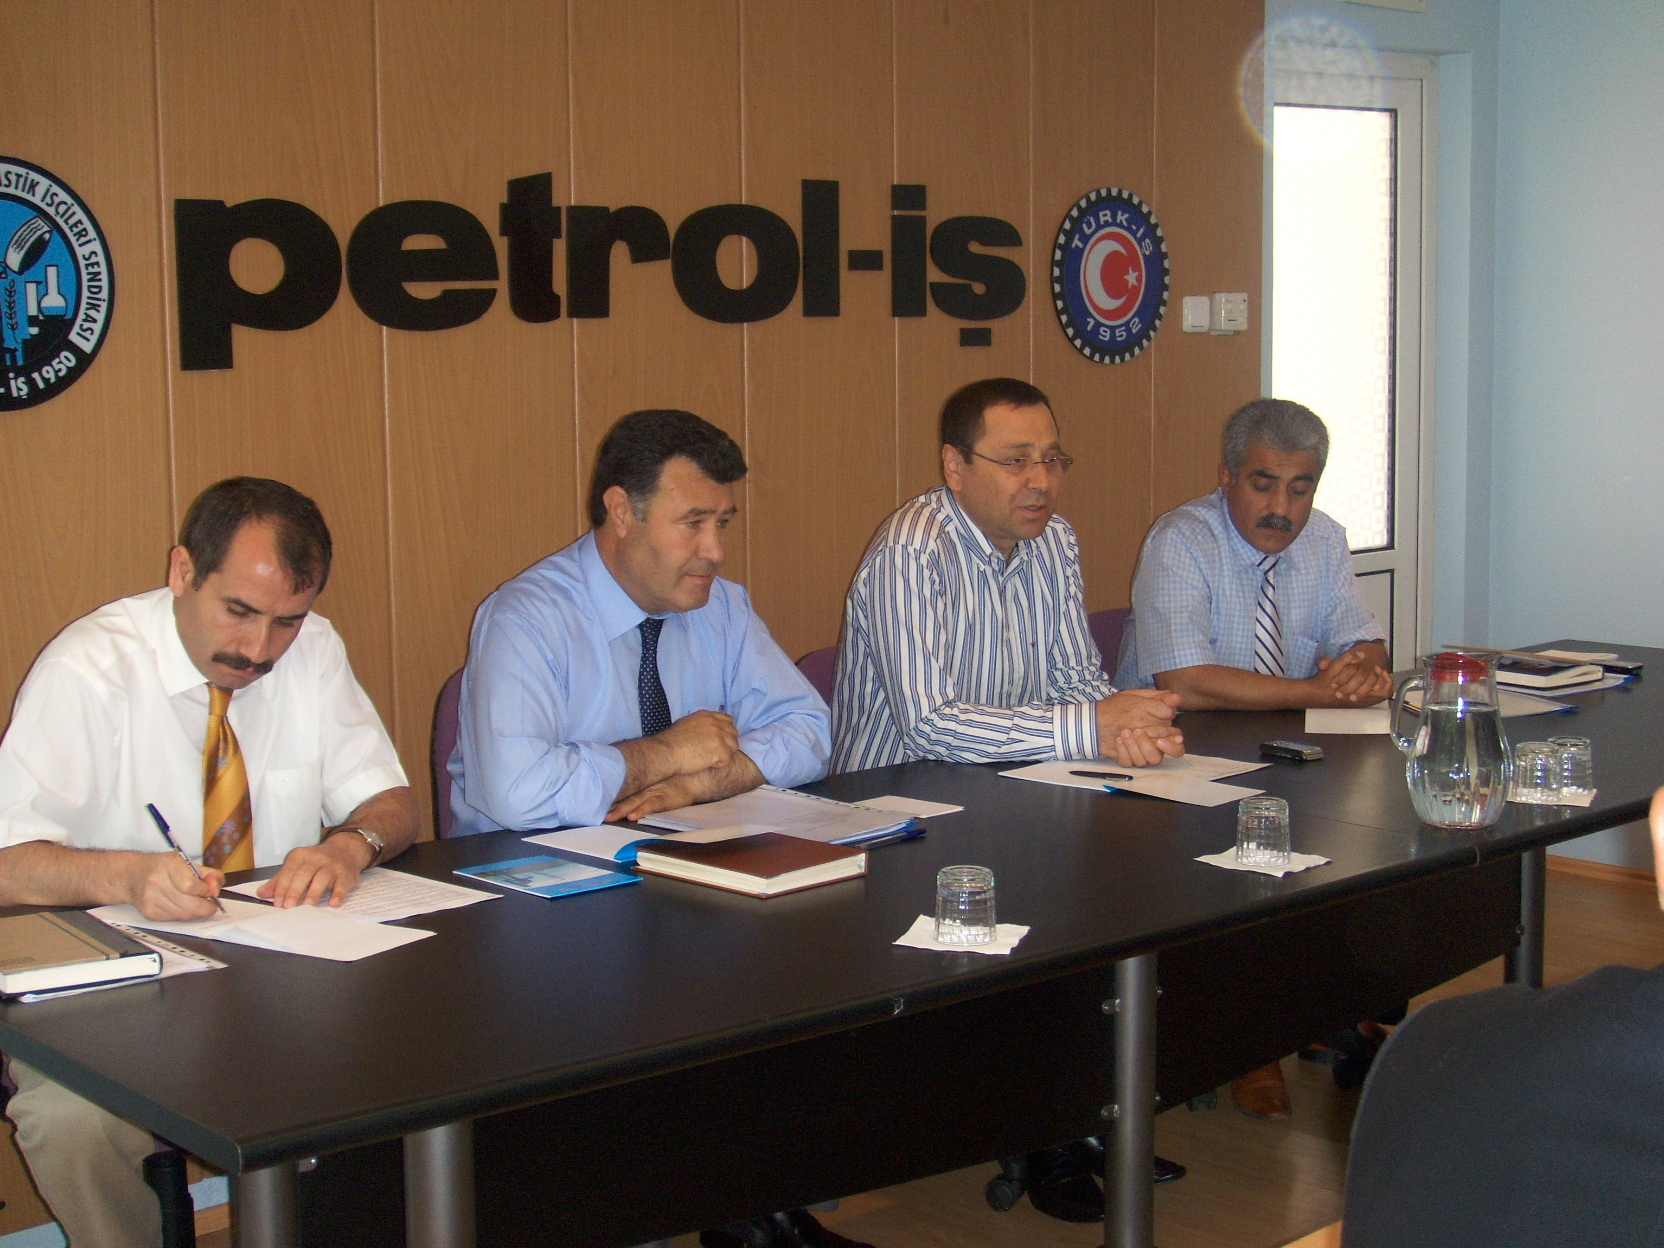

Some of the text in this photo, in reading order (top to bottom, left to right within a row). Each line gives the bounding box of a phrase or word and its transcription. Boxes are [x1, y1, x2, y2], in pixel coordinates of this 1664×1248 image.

[0, 170, 40, 198] STİK
[75, 250, 106, 342] SENDİKASI
[1086, 316, 1142, 341] 1952
[31, 350, 77, 389] 1950
